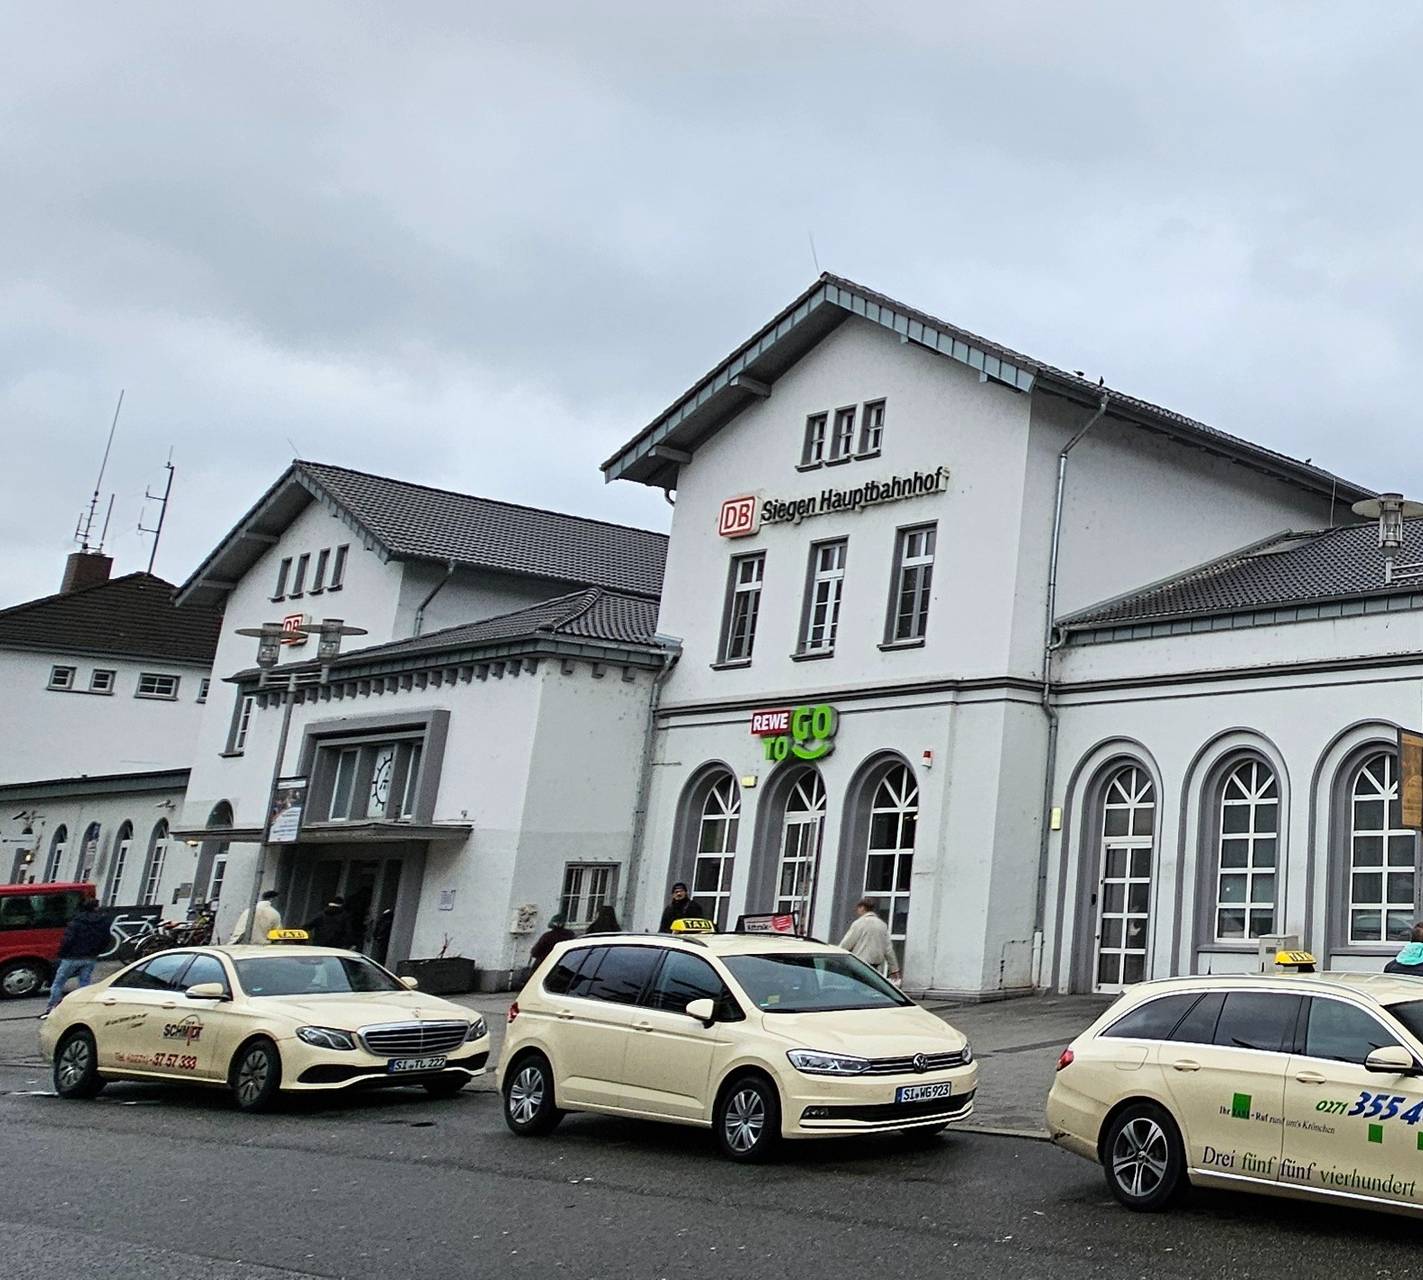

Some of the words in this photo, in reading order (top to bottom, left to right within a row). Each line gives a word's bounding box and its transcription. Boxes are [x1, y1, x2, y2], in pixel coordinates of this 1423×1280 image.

[724, 503, 750, 530] DB
[761, 497, 817, 522] Siegen
[819, 466, 943, 508] Hauptbahnhof
[753, 713, 789, 731] REWE
[792, 704, 833, 741] GO
[762, 735, 789, 761] TO
[687, 919, 711, 930] TAXI
[165, 1054, 178, 1068] 57
[179, 1056, 197, 1070] 333
[395, 1060, 407, 1070] SI
[903, 1088, 915, 1101] SI
[920, 1086, 932, 1099] WG
[932, 1084, 949, 1097] 923
[1315, 1100, 1349, 1115] 0271
[1256, 1111, 1268, 1122] Ruf
[1202, 1146, 1235, 1168] Drei
[1241, 1151, 1277, 1174] fünf
[1280, 1158, 1316, 1181] fünf
[1320, 1165, 1416, 1197] vierhundert
